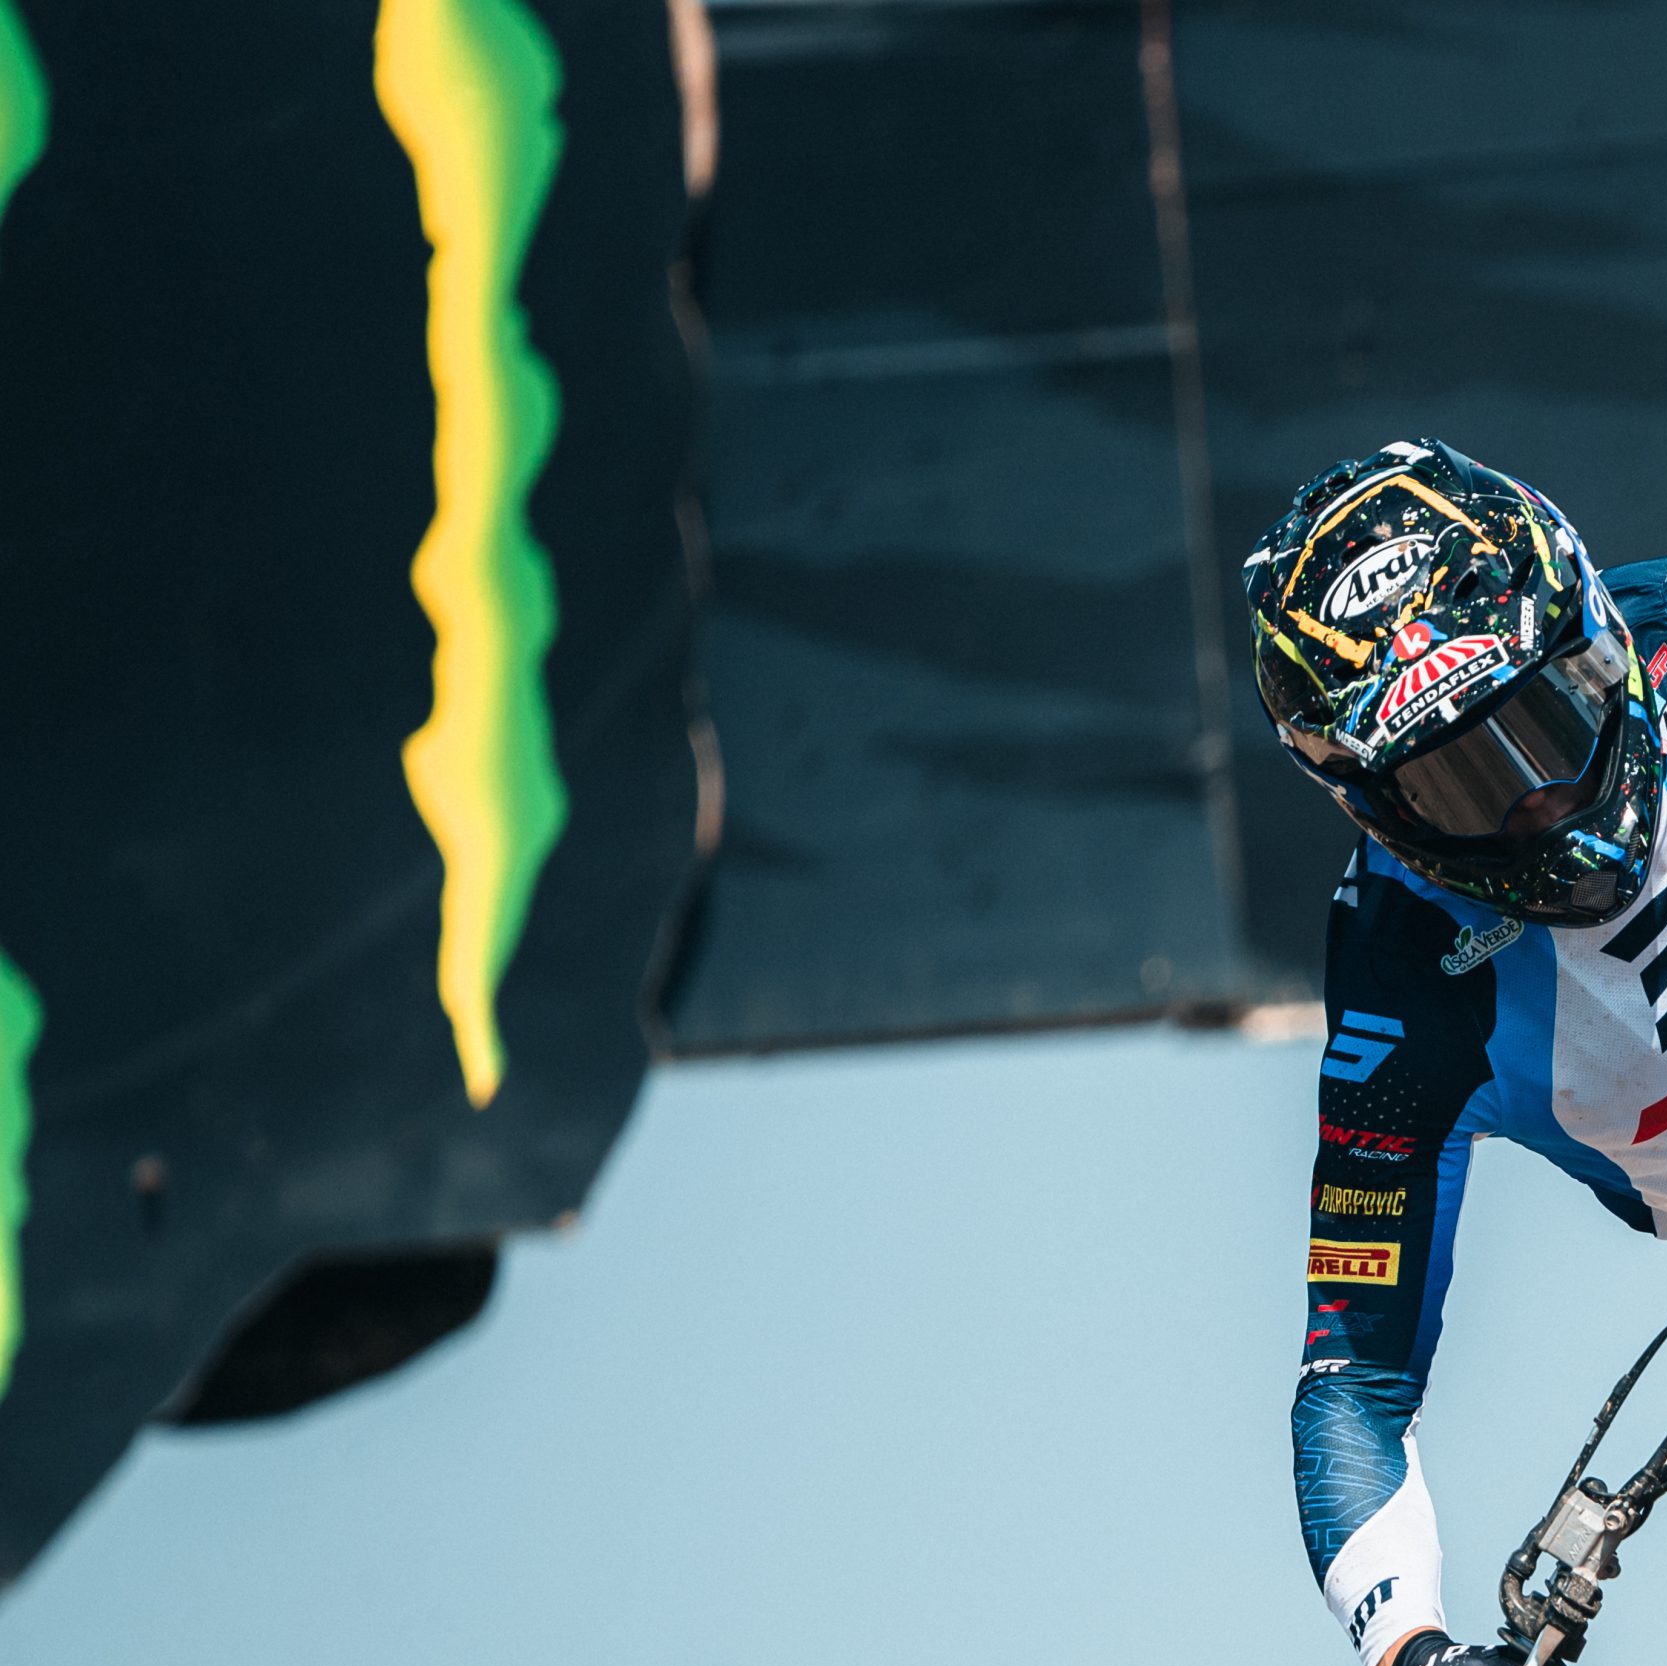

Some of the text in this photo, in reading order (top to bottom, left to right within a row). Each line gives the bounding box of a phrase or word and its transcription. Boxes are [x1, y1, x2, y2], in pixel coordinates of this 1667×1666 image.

[1338, 539, 1423, 619] Arai
[1391, 652, 1495, 729] TENDAFLEX
[1482, 920, 1519, 949] VERDE
[1349, 1147, 1410, 1163] RACING
